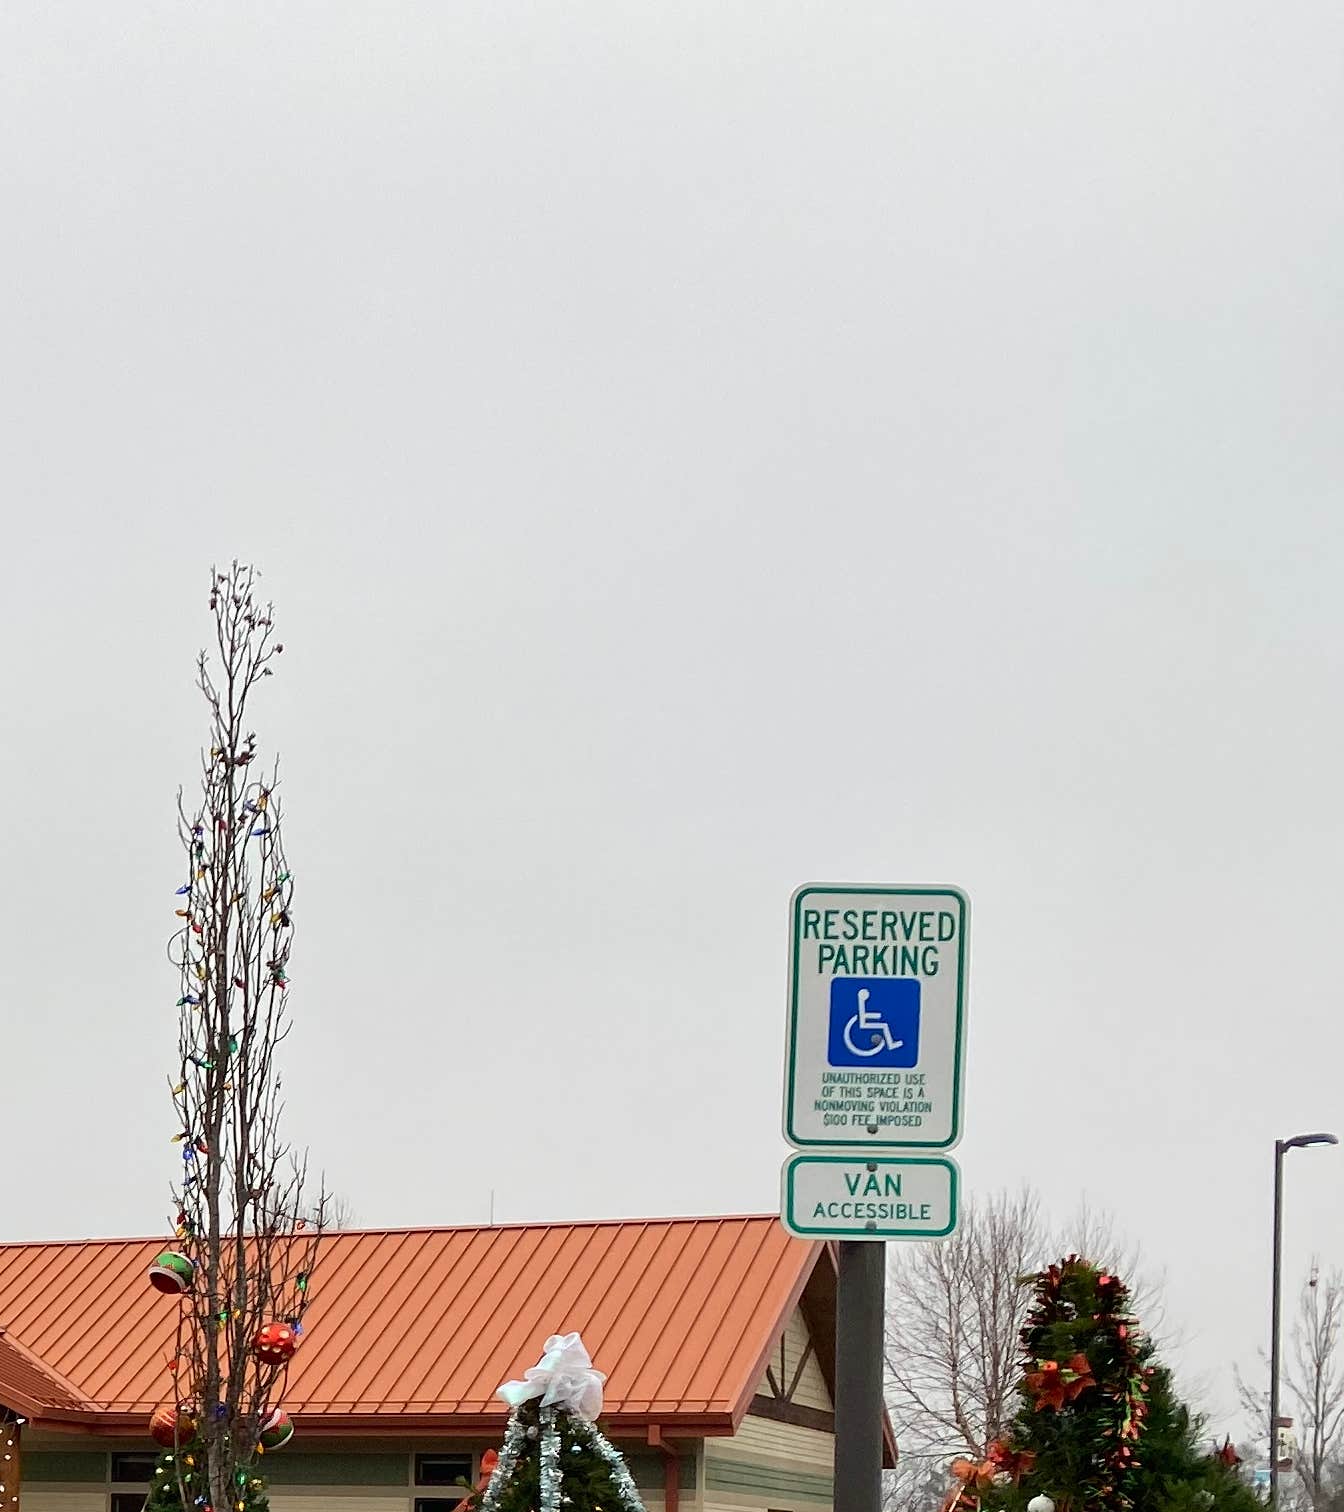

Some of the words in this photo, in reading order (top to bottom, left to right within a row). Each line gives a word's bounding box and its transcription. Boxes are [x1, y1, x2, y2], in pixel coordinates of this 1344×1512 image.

[803, 909, 955, 941] RESERVED
[818, 944, 939, 976] PARKING
[823, 1073, 900, 1084] UNAUTHORIZED
[906, 1074, 926, 1085] USE
[822, 1086, 834, 1097] OF
[840, 1087, 862, 1098] THIS
[867, 1087, 898, 1098] SPACE
[904, 1088, 913, 1099] IS
[917, 1088, 925, 1098] A
[814, 1100, 874, 1111] NONMOVING
[880, 1101, 932, 1112] VIOLATION
[823, 1113, 847, 1126] $100
[852, 1115, 871, 1126] FEE
[876, 1115, 922, 1126] IMPOSED
[844, 1173, 901, 1196] VAN
[813, 1202, 930, 1220] ACCESSIBLE
